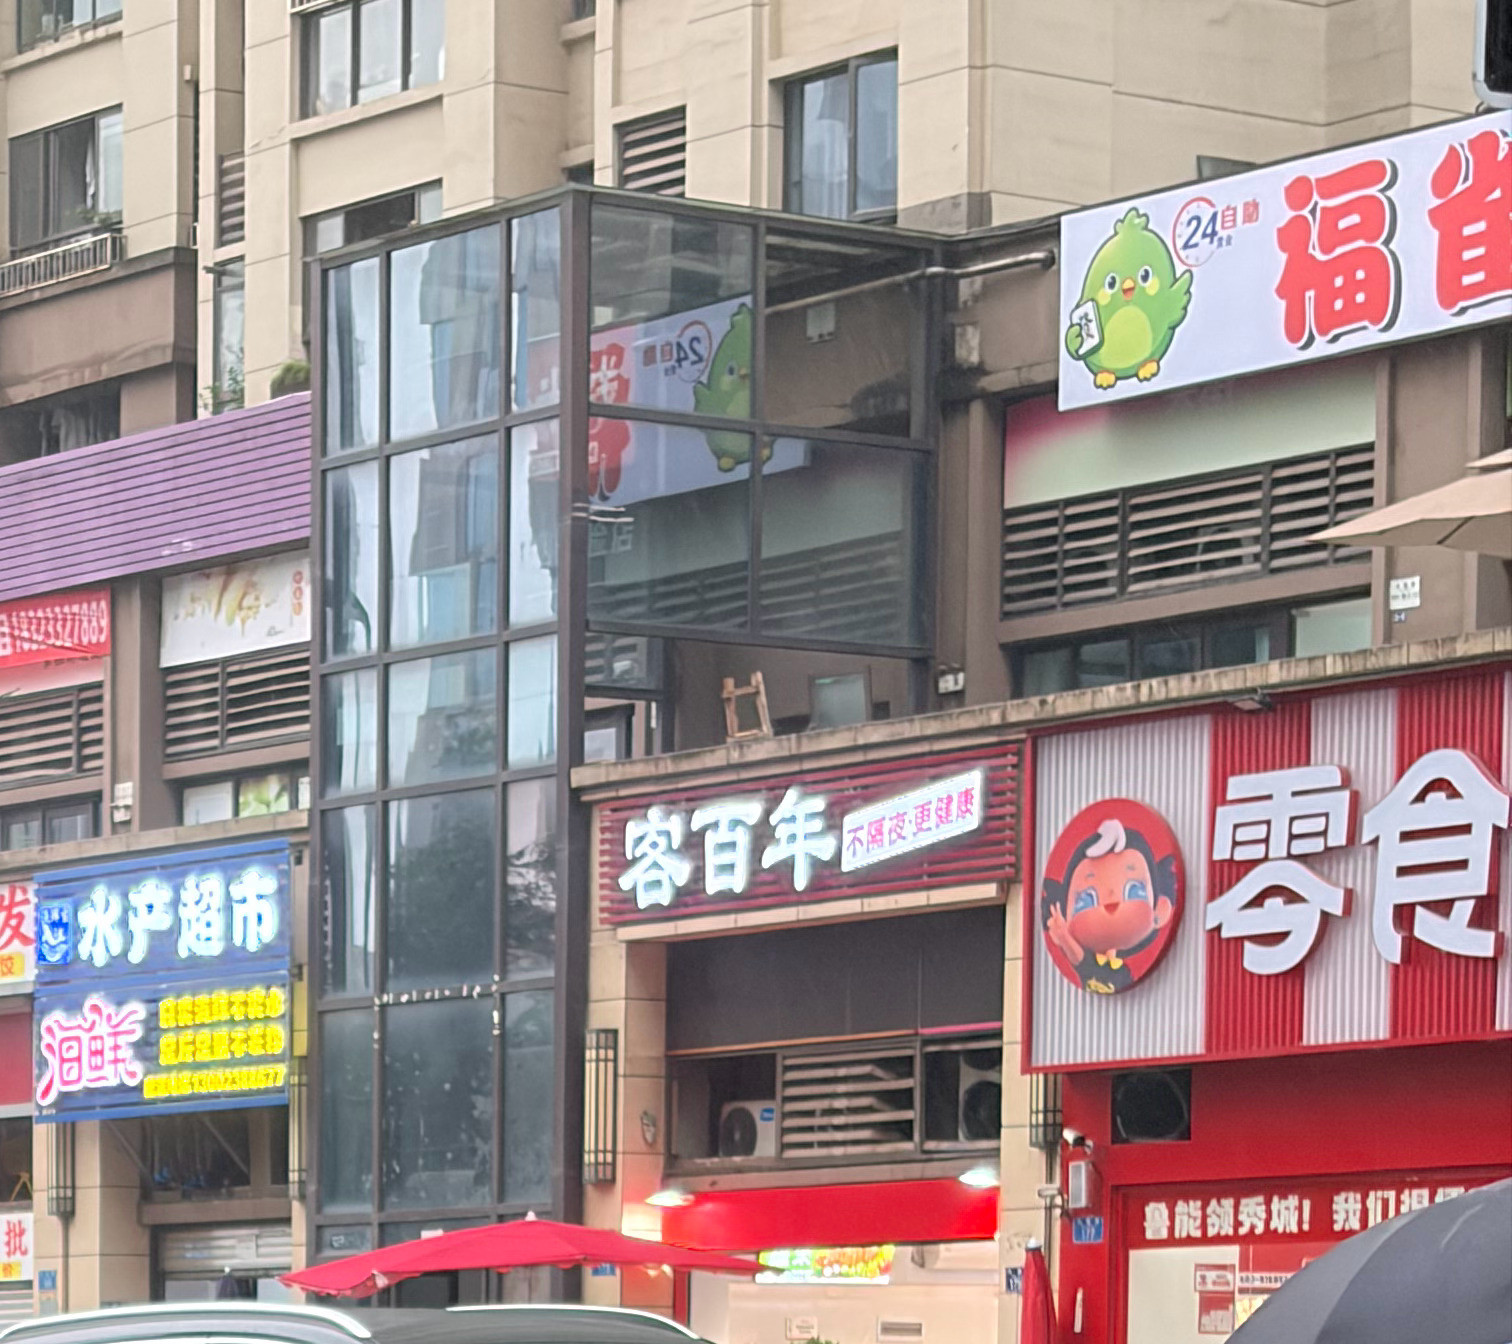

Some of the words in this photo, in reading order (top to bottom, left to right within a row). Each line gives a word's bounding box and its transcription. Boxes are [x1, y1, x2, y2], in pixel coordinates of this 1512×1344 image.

[618, 787, 838, 909] 客百年
[1206, 748, 1510, 975] 零食
[77, 870, 278, 967] 水产超市
